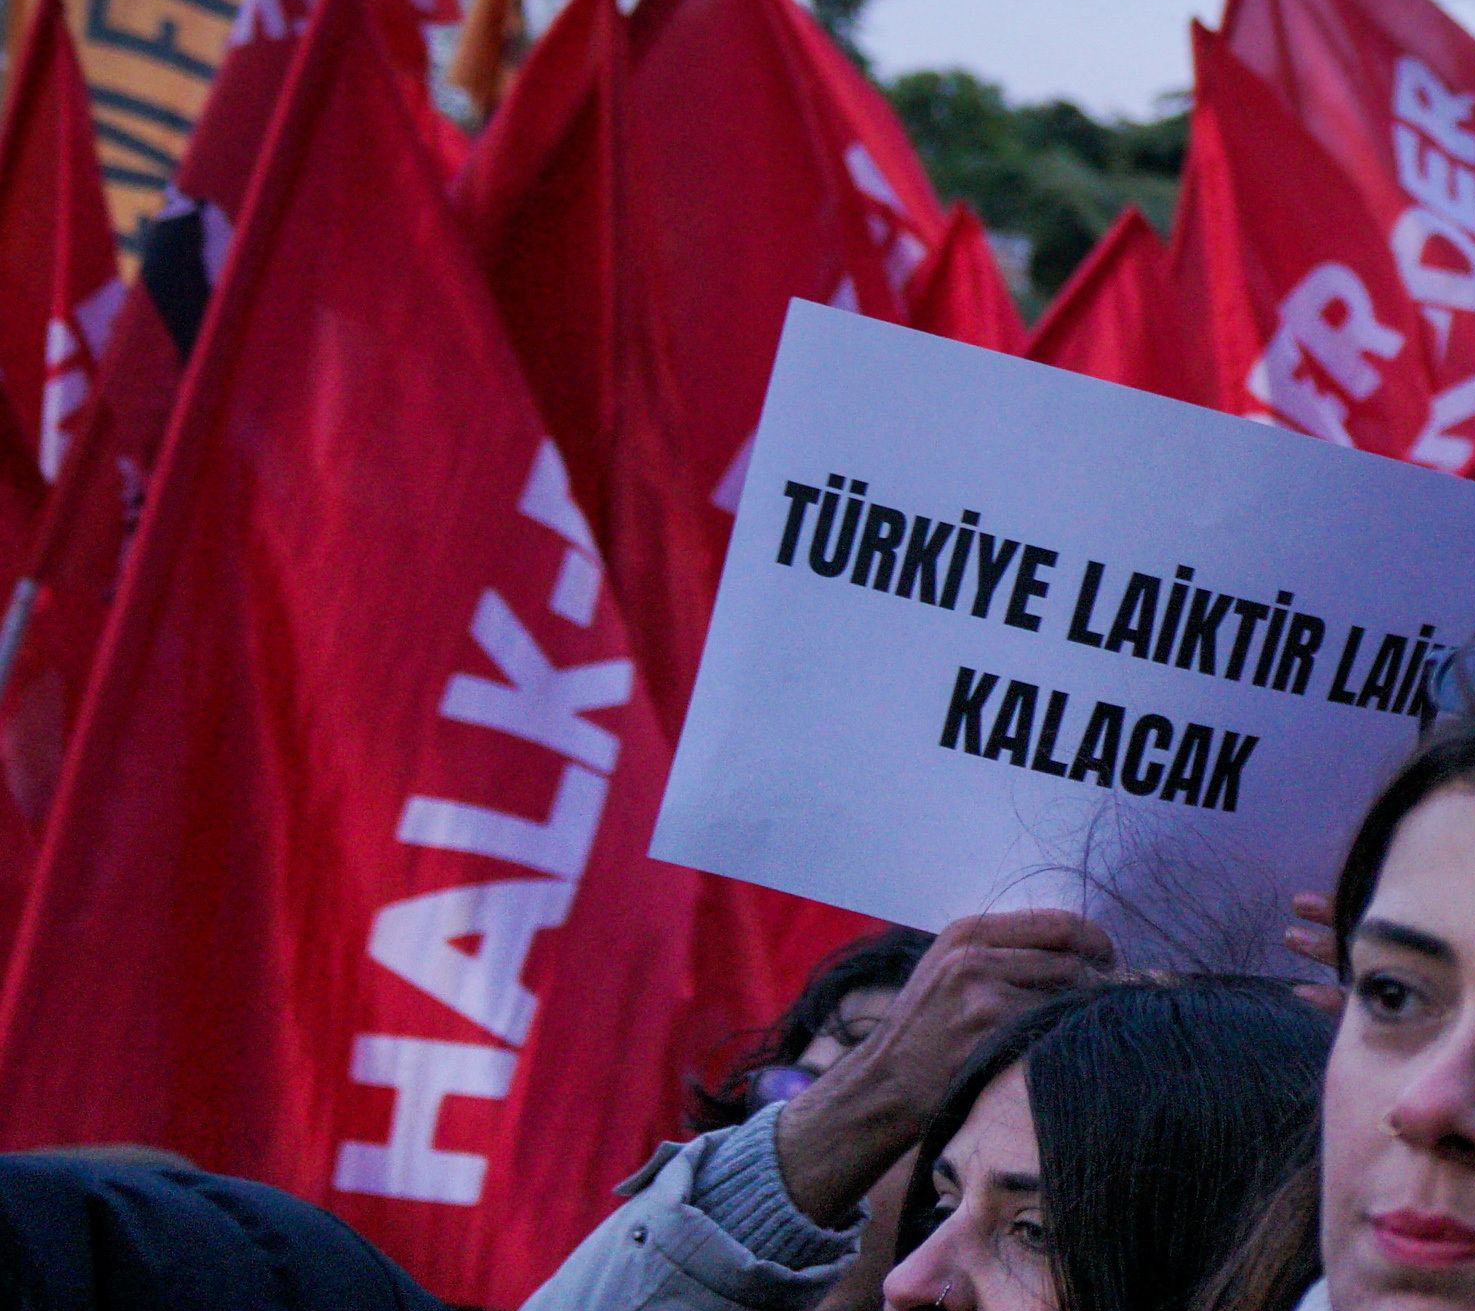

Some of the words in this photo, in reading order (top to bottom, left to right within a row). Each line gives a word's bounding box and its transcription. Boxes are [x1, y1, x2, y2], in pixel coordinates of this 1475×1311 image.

[775, 473, 1060, 633] TÜRKİYE
[1066, 564, 1326, 697] LAİKTİR
[938, 666, 1260, 814] KALACAK
